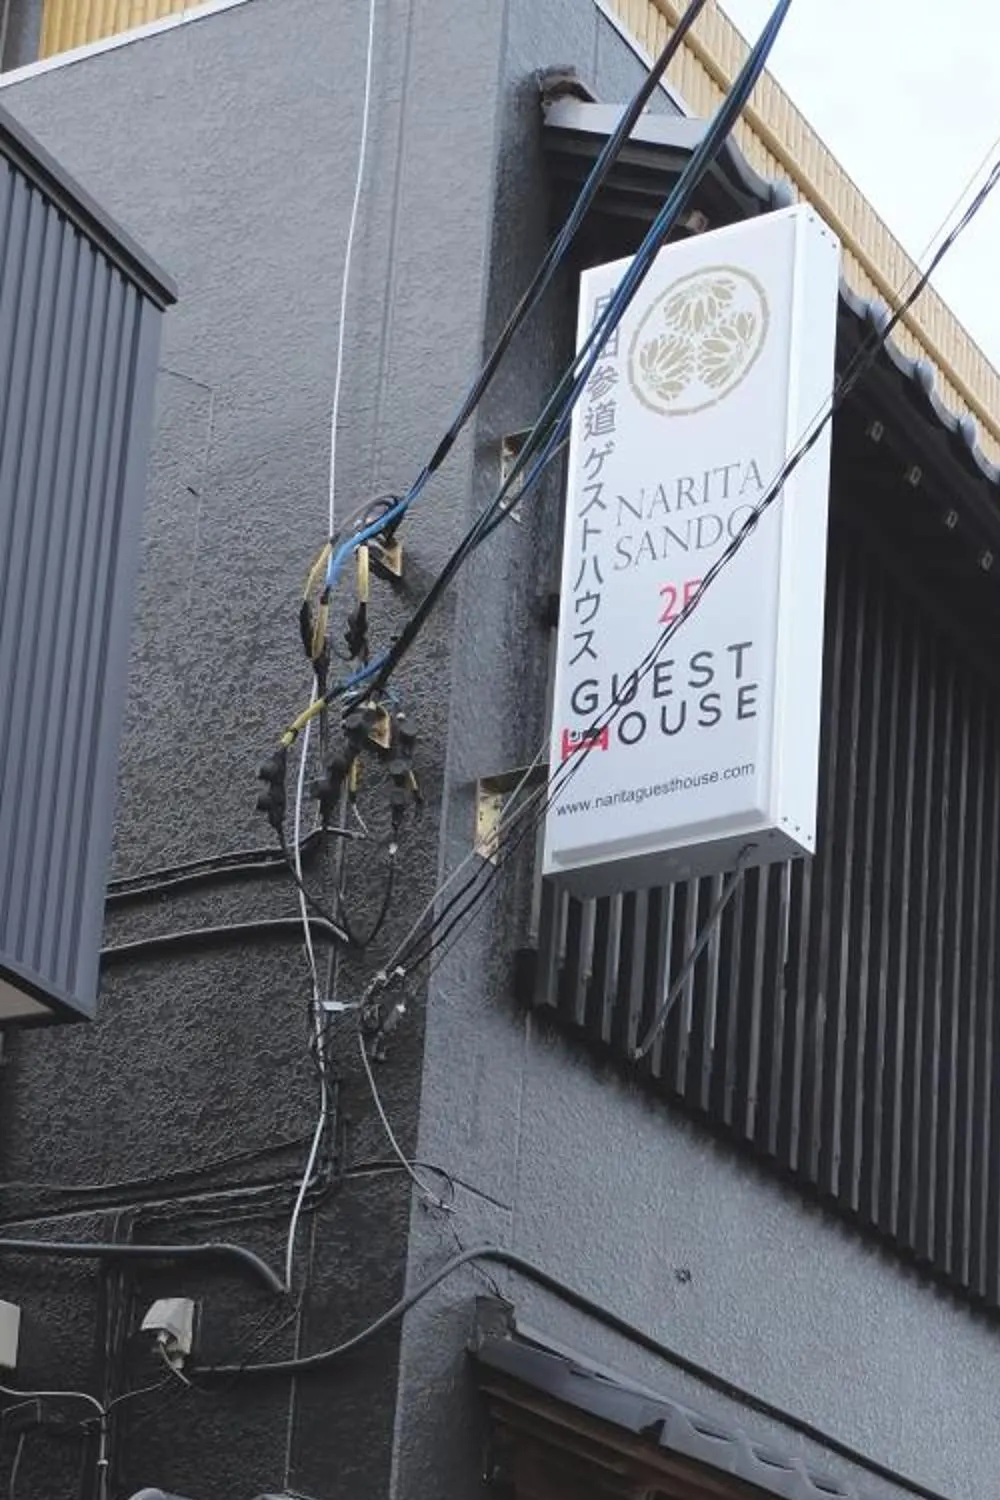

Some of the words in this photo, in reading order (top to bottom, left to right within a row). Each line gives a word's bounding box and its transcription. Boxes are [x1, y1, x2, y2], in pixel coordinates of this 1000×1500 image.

[617, 459, 764, 527] NARITA
[613, 503, 759, 571] SANDO
[658, 578, 703, 625] 2F
[570, 641, 753, 716] GUEST
[555, 762, 756, 817] www.naritaguesthouse.com
